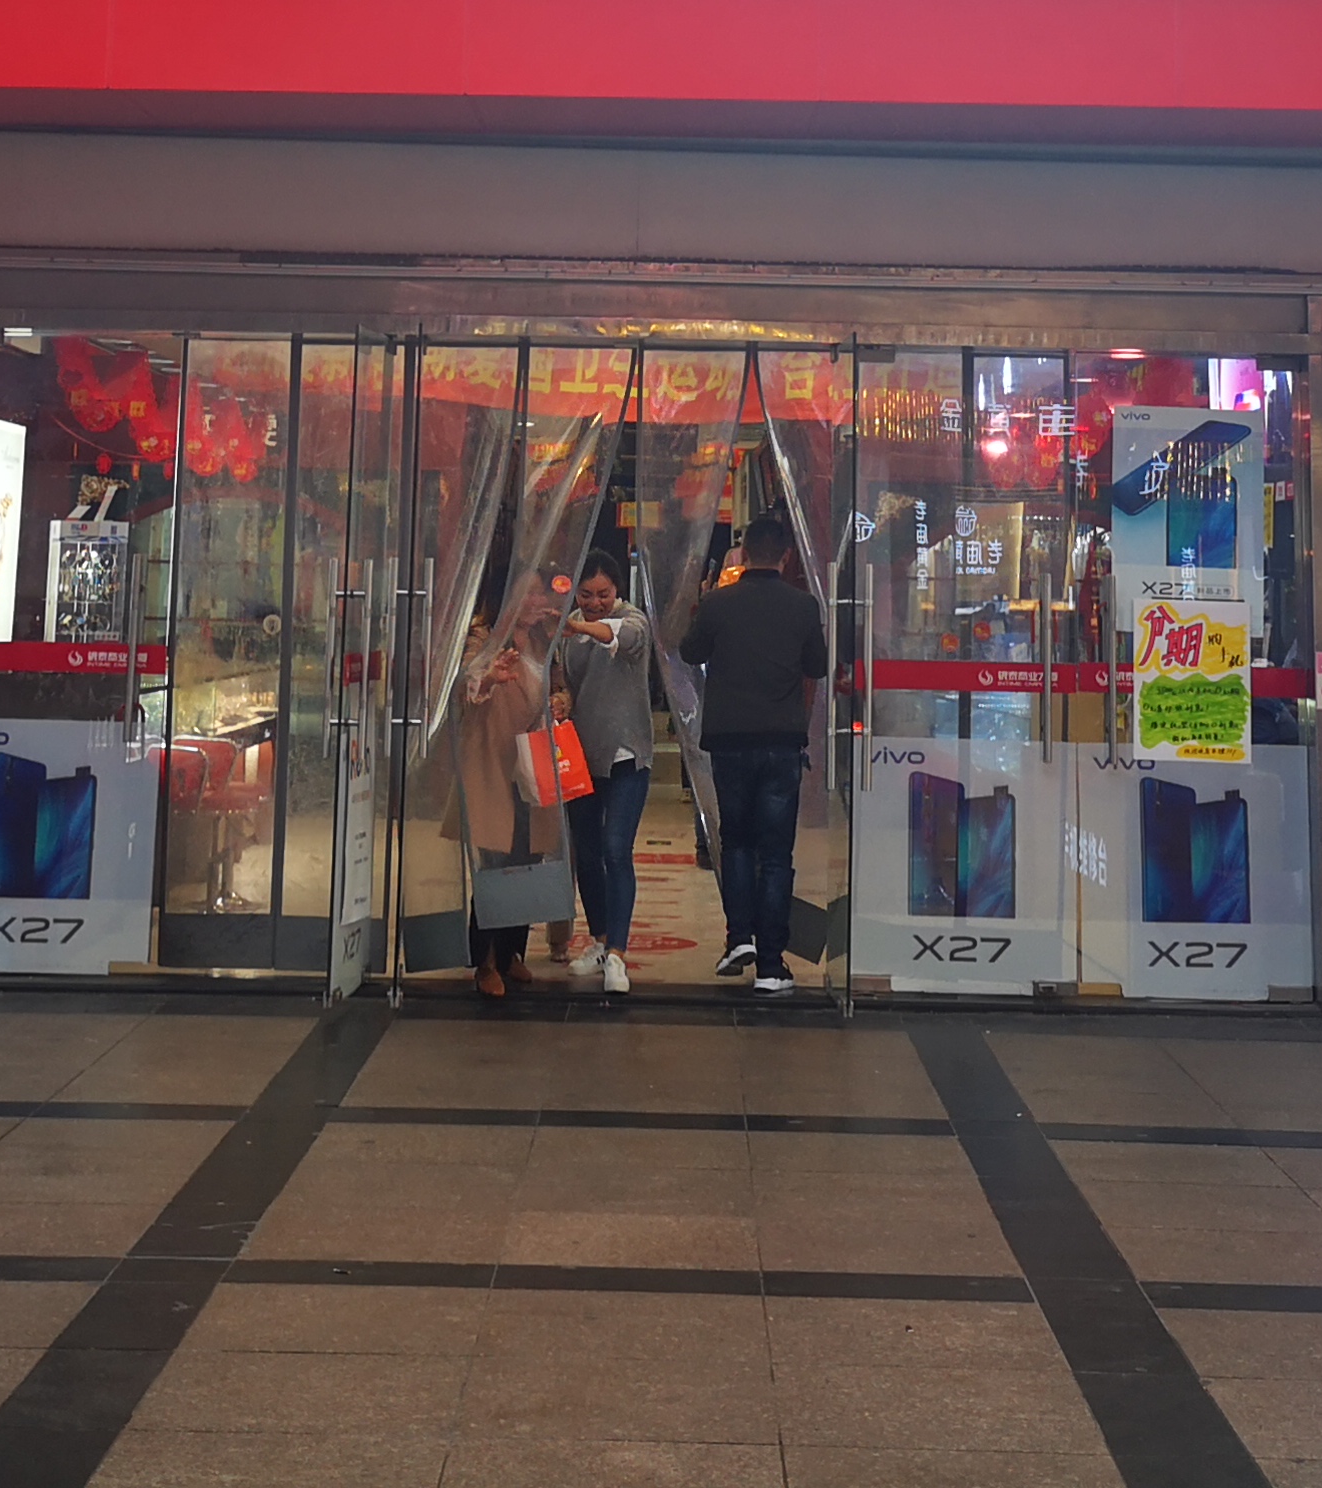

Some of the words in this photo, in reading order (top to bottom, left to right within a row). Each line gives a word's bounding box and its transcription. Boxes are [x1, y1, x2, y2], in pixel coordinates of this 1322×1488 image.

[1121, 412, 1150, 421] vivo
[912, 935, 1012, 964] X27
[1148, 942, 1248, 969] X27
